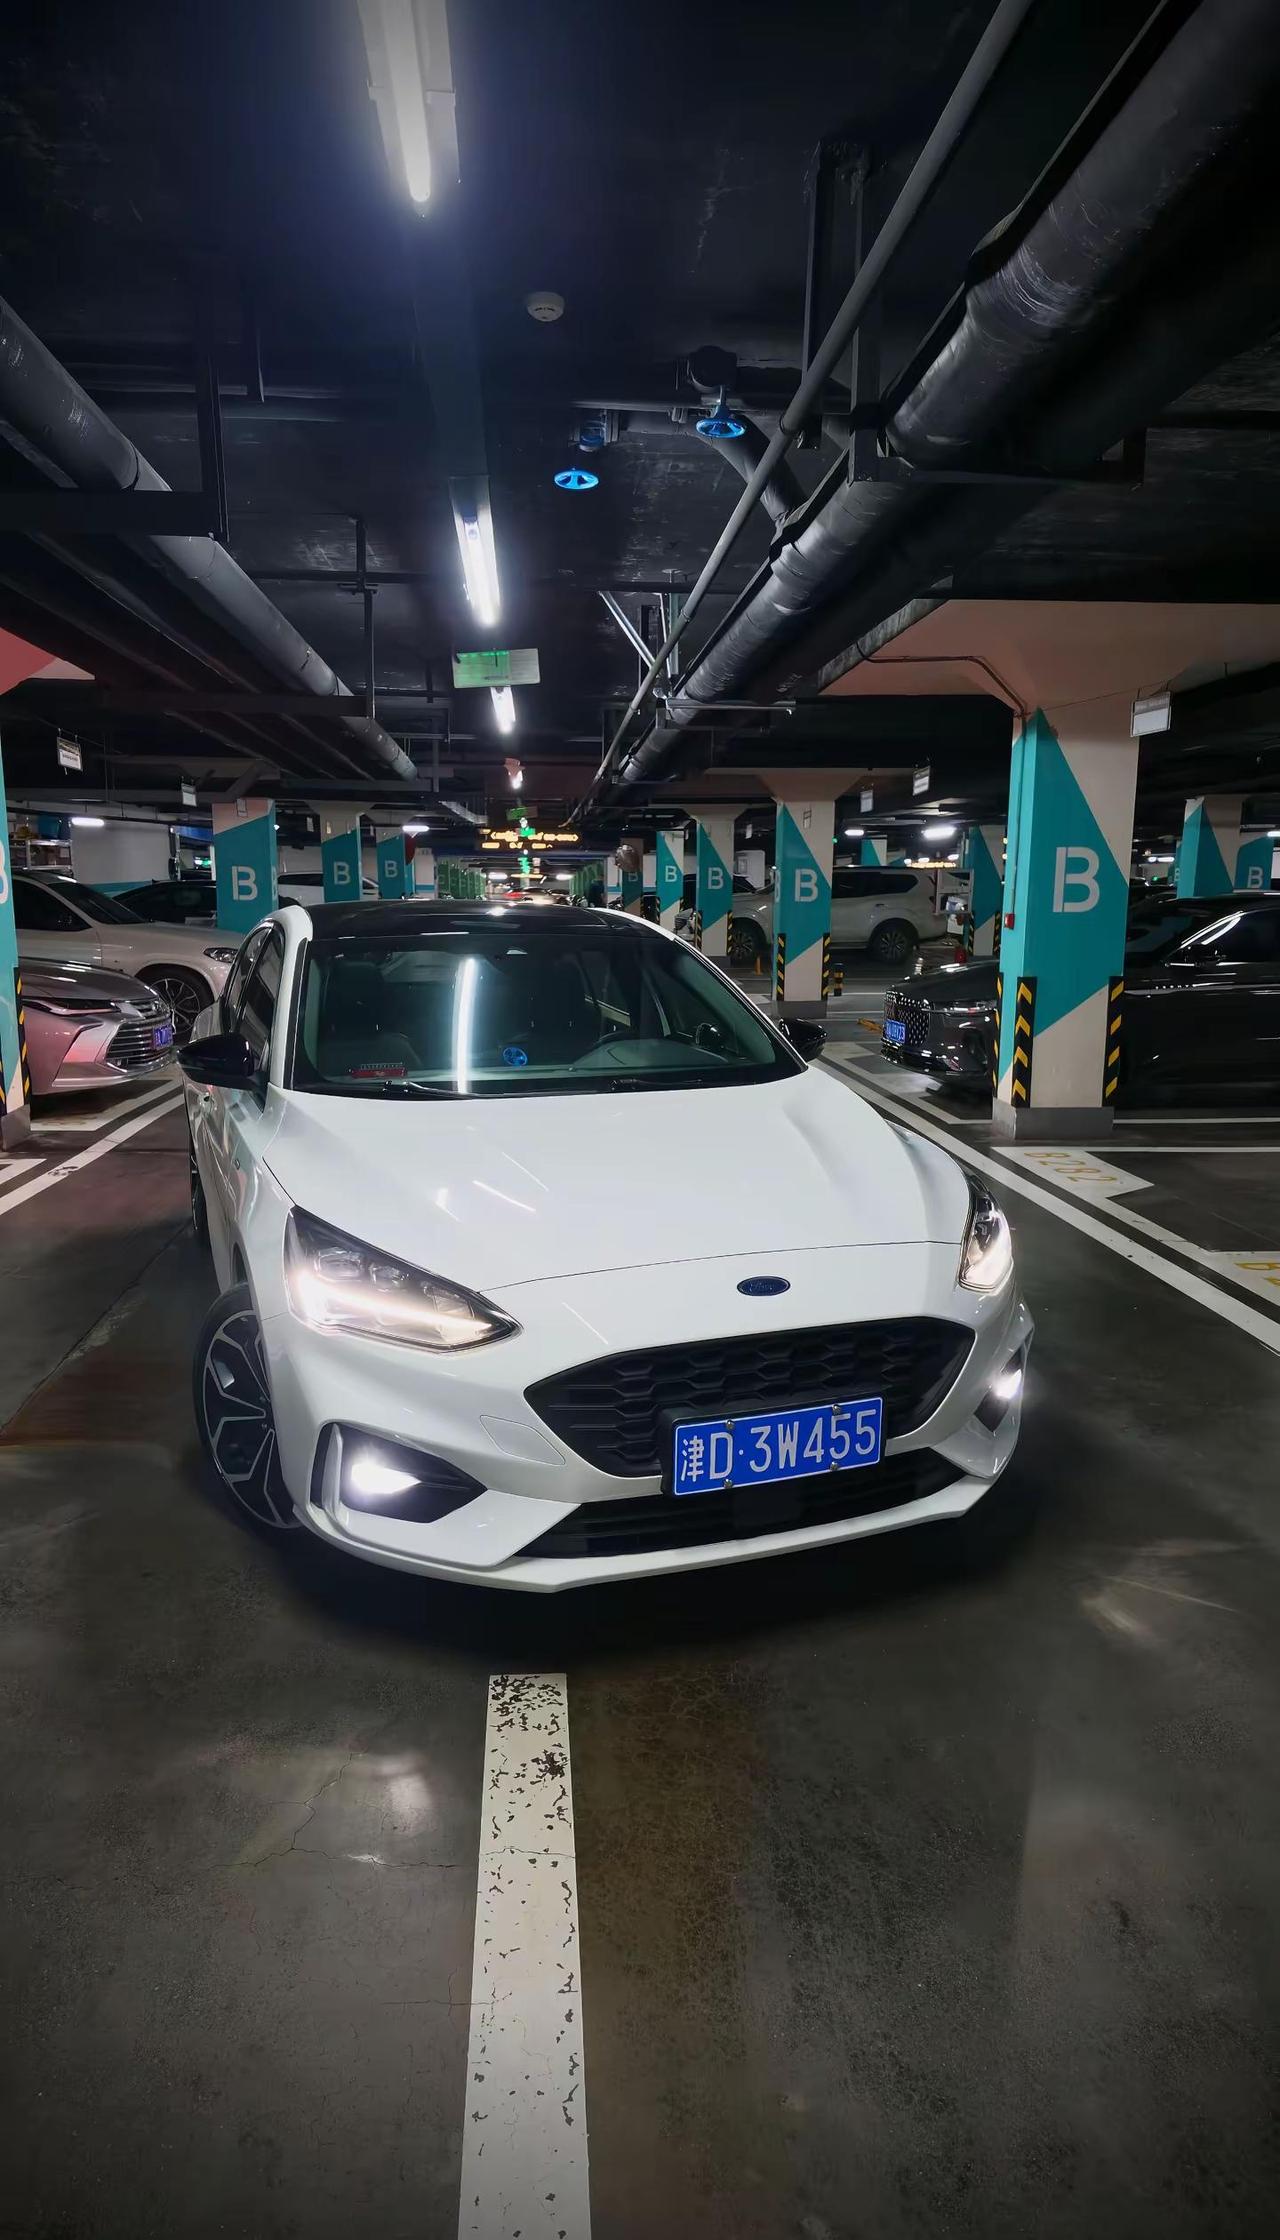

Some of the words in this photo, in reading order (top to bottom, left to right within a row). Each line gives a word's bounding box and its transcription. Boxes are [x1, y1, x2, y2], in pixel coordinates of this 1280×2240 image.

[333, 861, 351, 885] B
[384, 860, 399, 878] B
[665, 865, 678, 883] B
[707, 866, 724, 890] B
[1052, 847, 1100, 913] B
[1247, 866, 1264, 889] B
[231, 866, 258, 901] B
[794, 868, 819, 902] B
